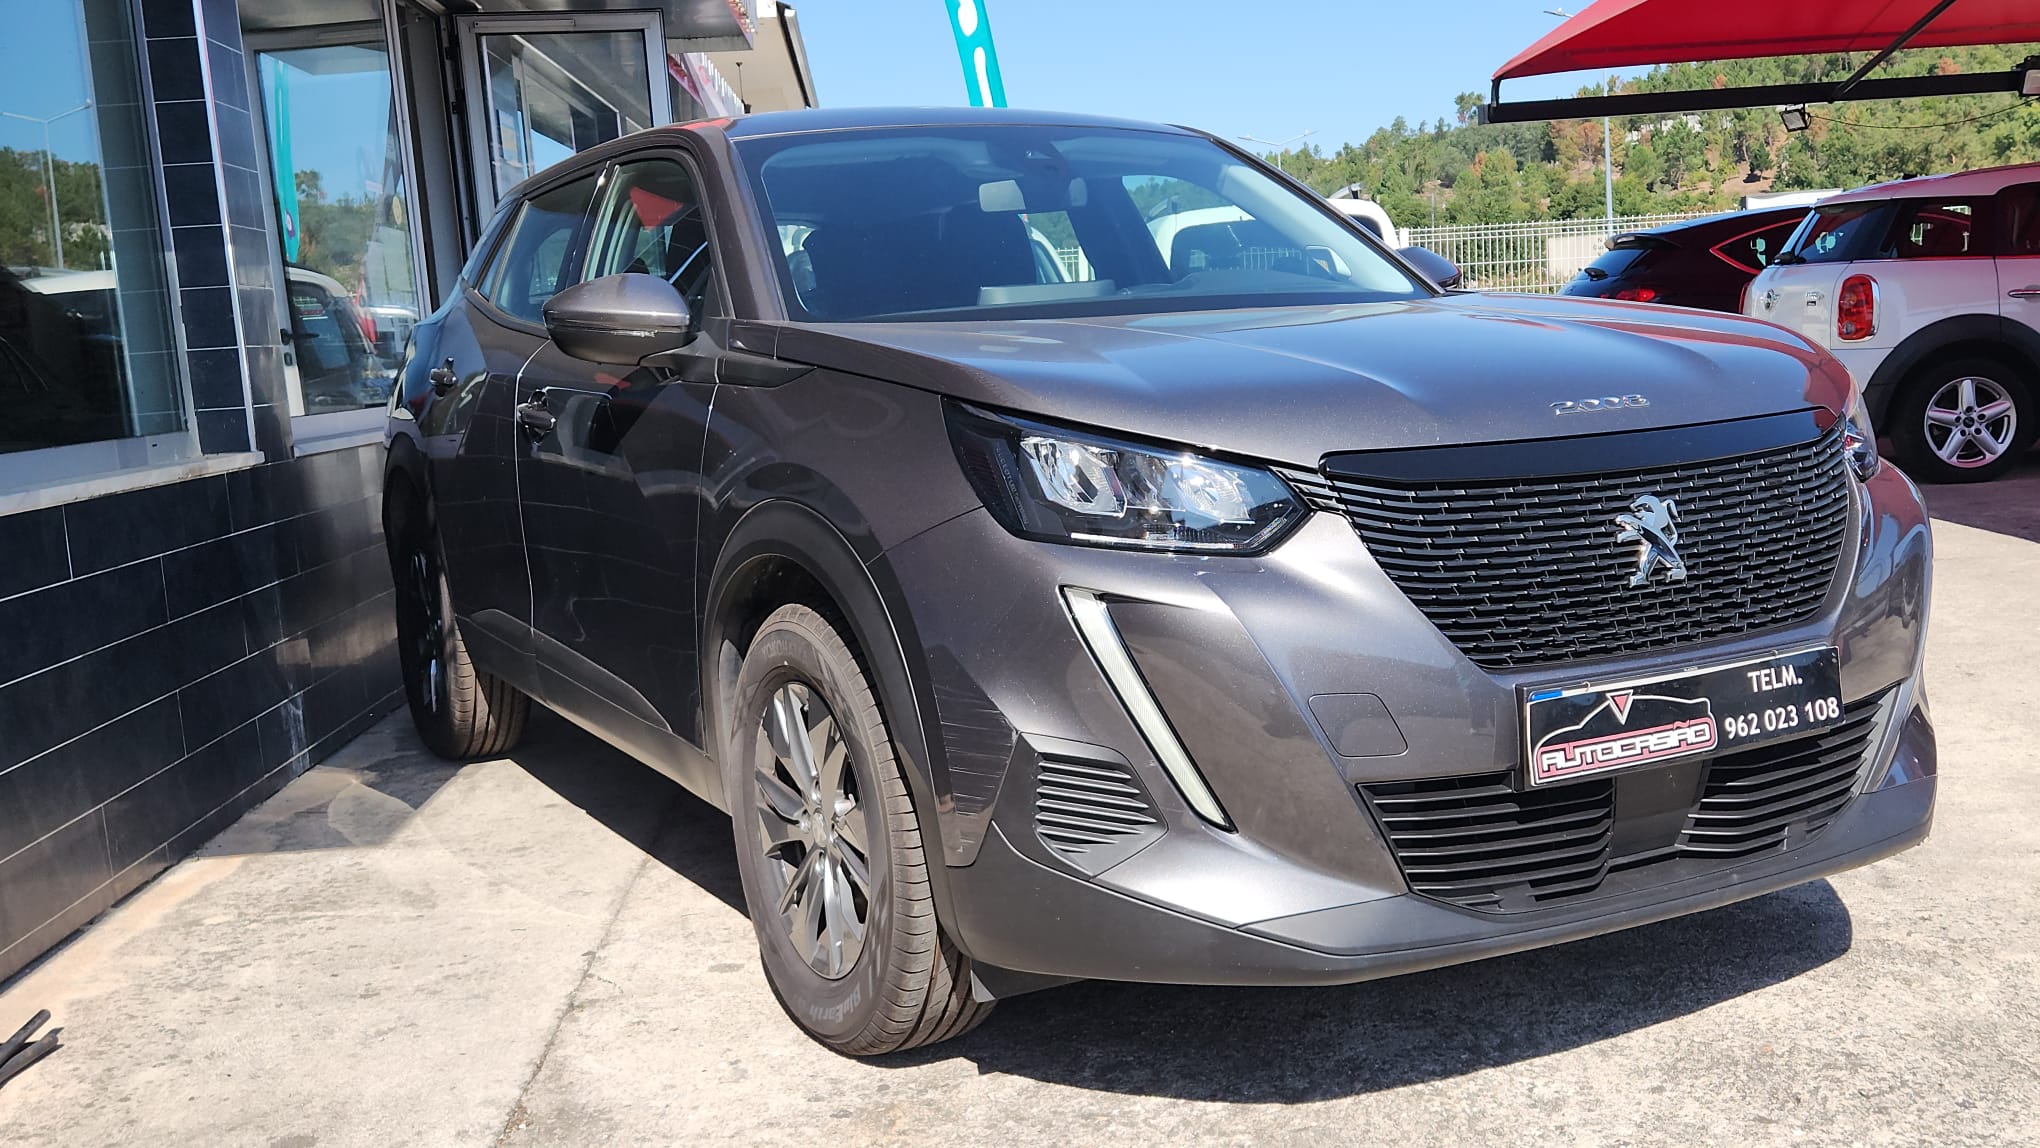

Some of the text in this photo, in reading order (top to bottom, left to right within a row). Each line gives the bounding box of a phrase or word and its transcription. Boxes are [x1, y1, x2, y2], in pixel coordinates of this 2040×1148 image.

[1549, 394, 1651, 416] 2008
[761, 639, 809, 659] YOKOHA
[1746, 664, 1804, 693] TELM.
[1724, 697, 1840, 740] 962 023 108
[1541, 721, 1712, 773] AUTOCASIÃO
